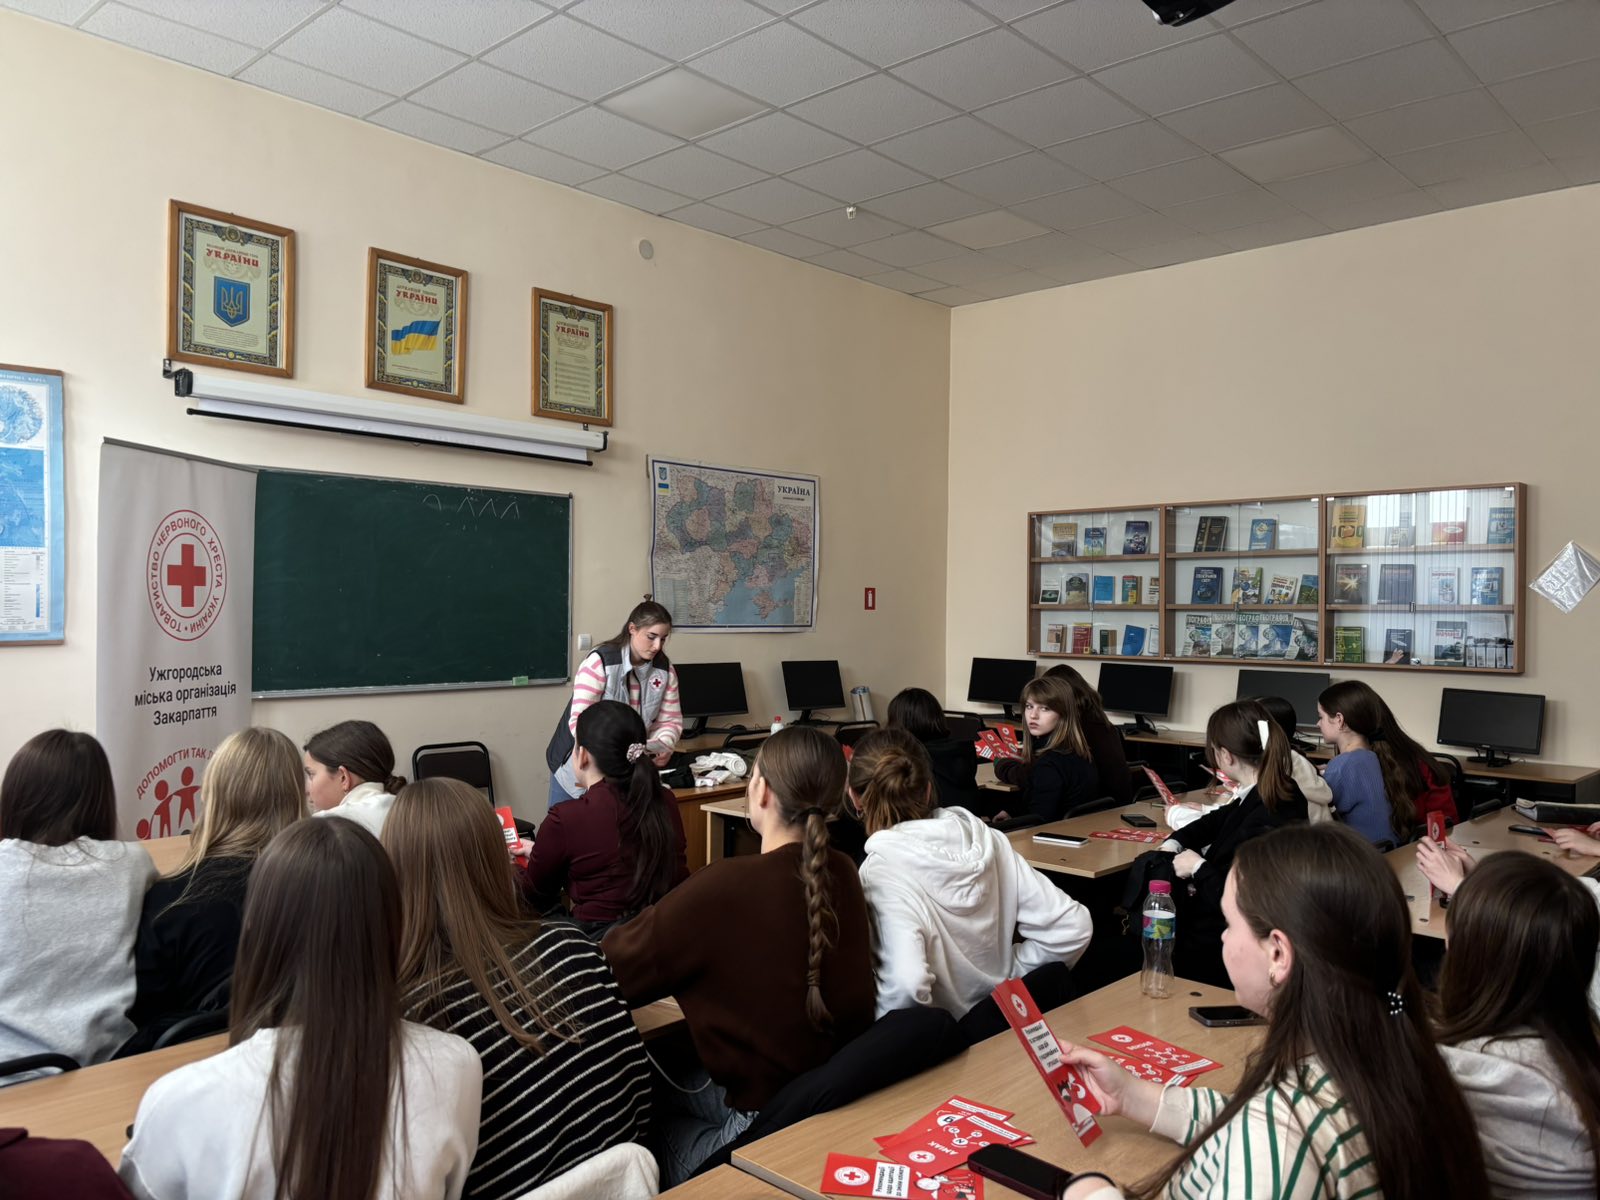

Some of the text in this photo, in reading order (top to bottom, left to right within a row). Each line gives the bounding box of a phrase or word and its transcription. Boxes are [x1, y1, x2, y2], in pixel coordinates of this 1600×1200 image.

[206, 248, 259, 268] УКРАЇНИ
[396, 290, 438, 305] УКРАЇНИ
[556, 325, 589, 338] УКРАЇНИ
[777, 485, 811, 496] УКРАЇНА
[151, 517, 223, 633] ТОВАРИСТВО ЧЕРВОНОГО ХРЕСТА УКРАЇНИ
[149, 664, 223, 683] Ужгородська
[134, 681, 237, 706] міська організація
[153, 706, 217, 726] Закарпаття
[136, 747, 207, 800] ДОПОМОГТИ ТАК
